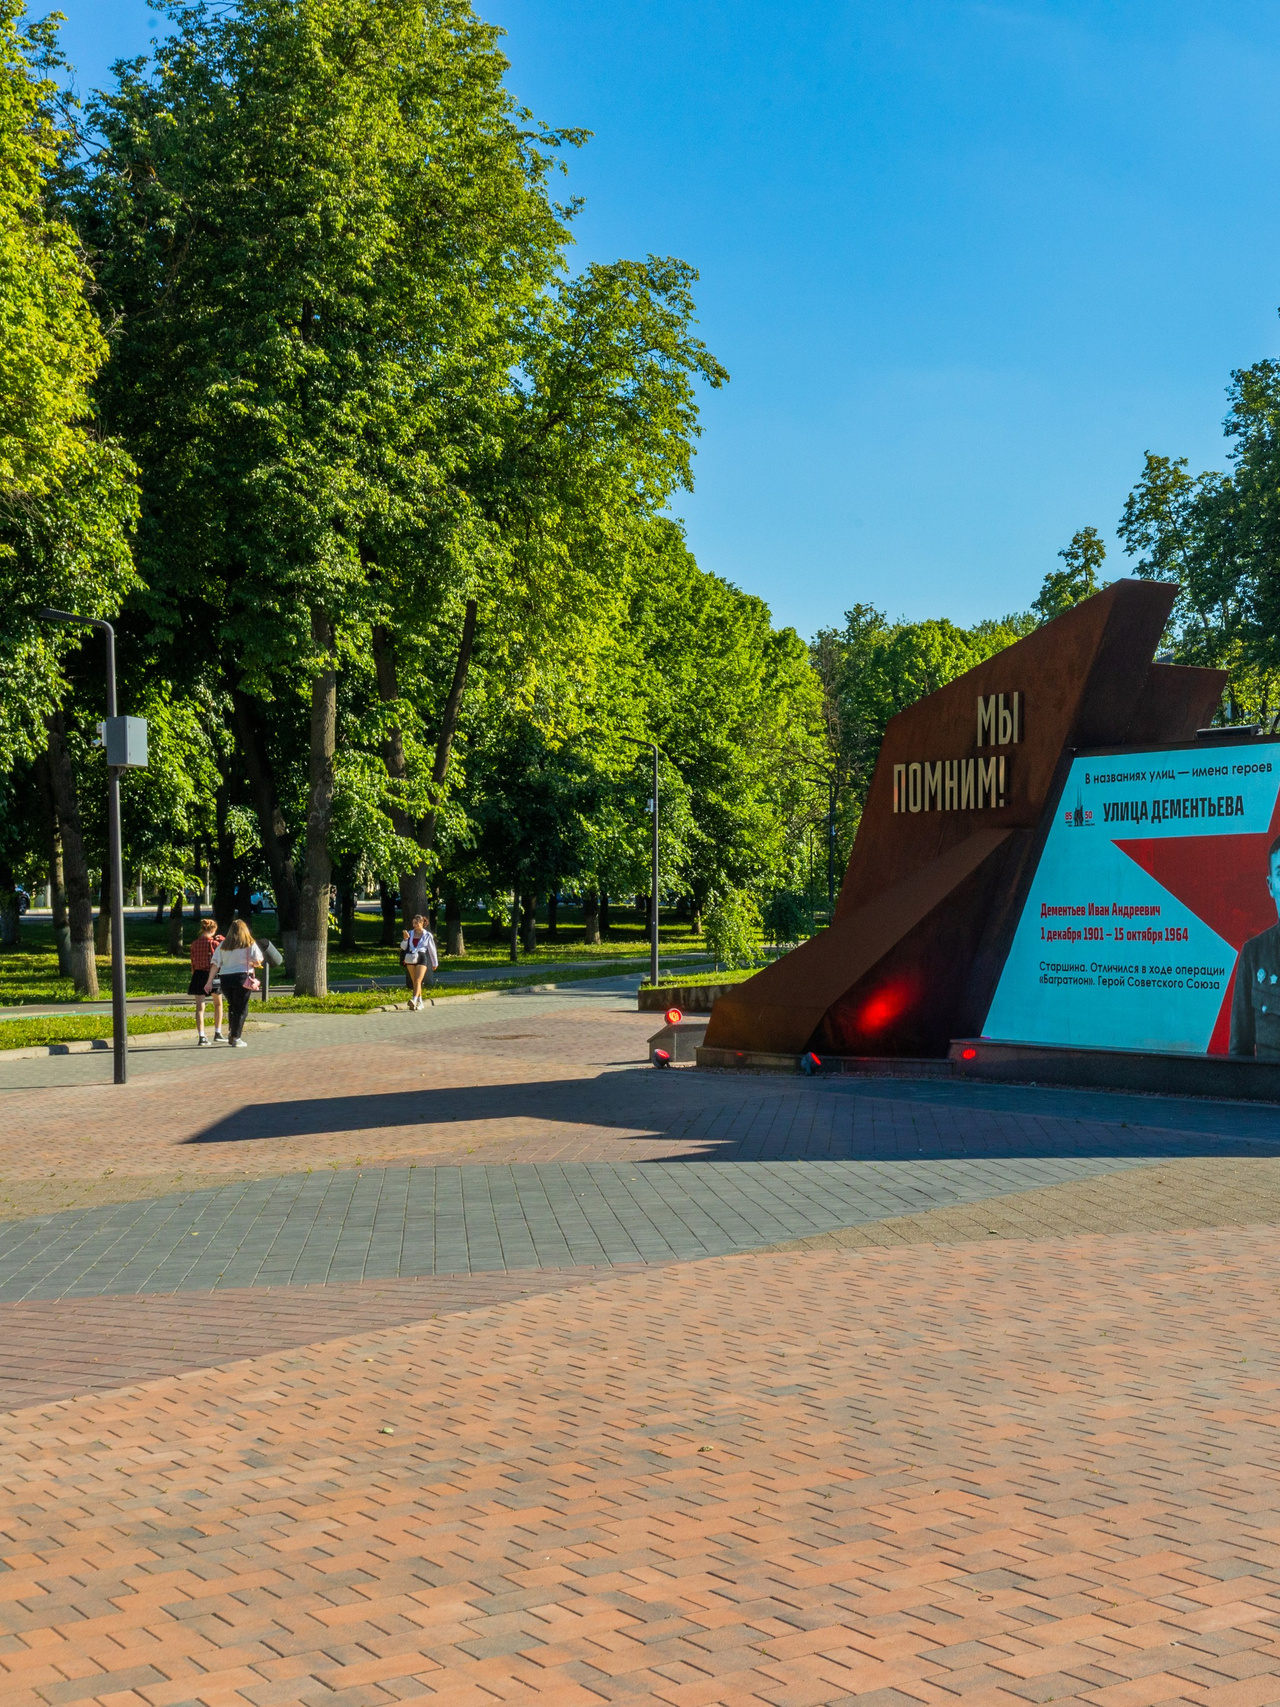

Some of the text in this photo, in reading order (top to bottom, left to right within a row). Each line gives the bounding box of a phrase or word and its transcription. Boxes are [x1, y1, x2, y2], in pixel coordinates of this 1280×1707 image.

[977, 691, 1019, 747] МЫ
[1085, 773, 1091, 785] В
[1093, 771, 1147, 784] названиях
[1149, 769, 1175, 782] улиц
[1192, 766, 1228, 778] имена
[1232, 762, 1273, 776] героев
[893, 756, 1005, 813] ПОМНИМ!
[1103, 795, 1245, 824] УЛИЦА ДЕМЕНТЬЕВА
[1040, 903, 1161, 919] Дементьев Иван Андреевич
[1040, 927, 1045, 940] 1
[1047, 927, 1082, 943] декабря
[1084, 928, 1104, 941] 1901
[1114, 928, 1125, 941] 15
[1127, 927, 1163, 944] октября
[1165, 928, 1189, 942] 1964
[1039, 962, 1088, 973] Старшина.
[1090, 963, 1139, 974] Отличился
[1149, 965, 1172, 975] ходе
[1175, 967, 1225, 977] операции
[1039, 974, 1220, 990] «Багратион». Герой Советского Союза
